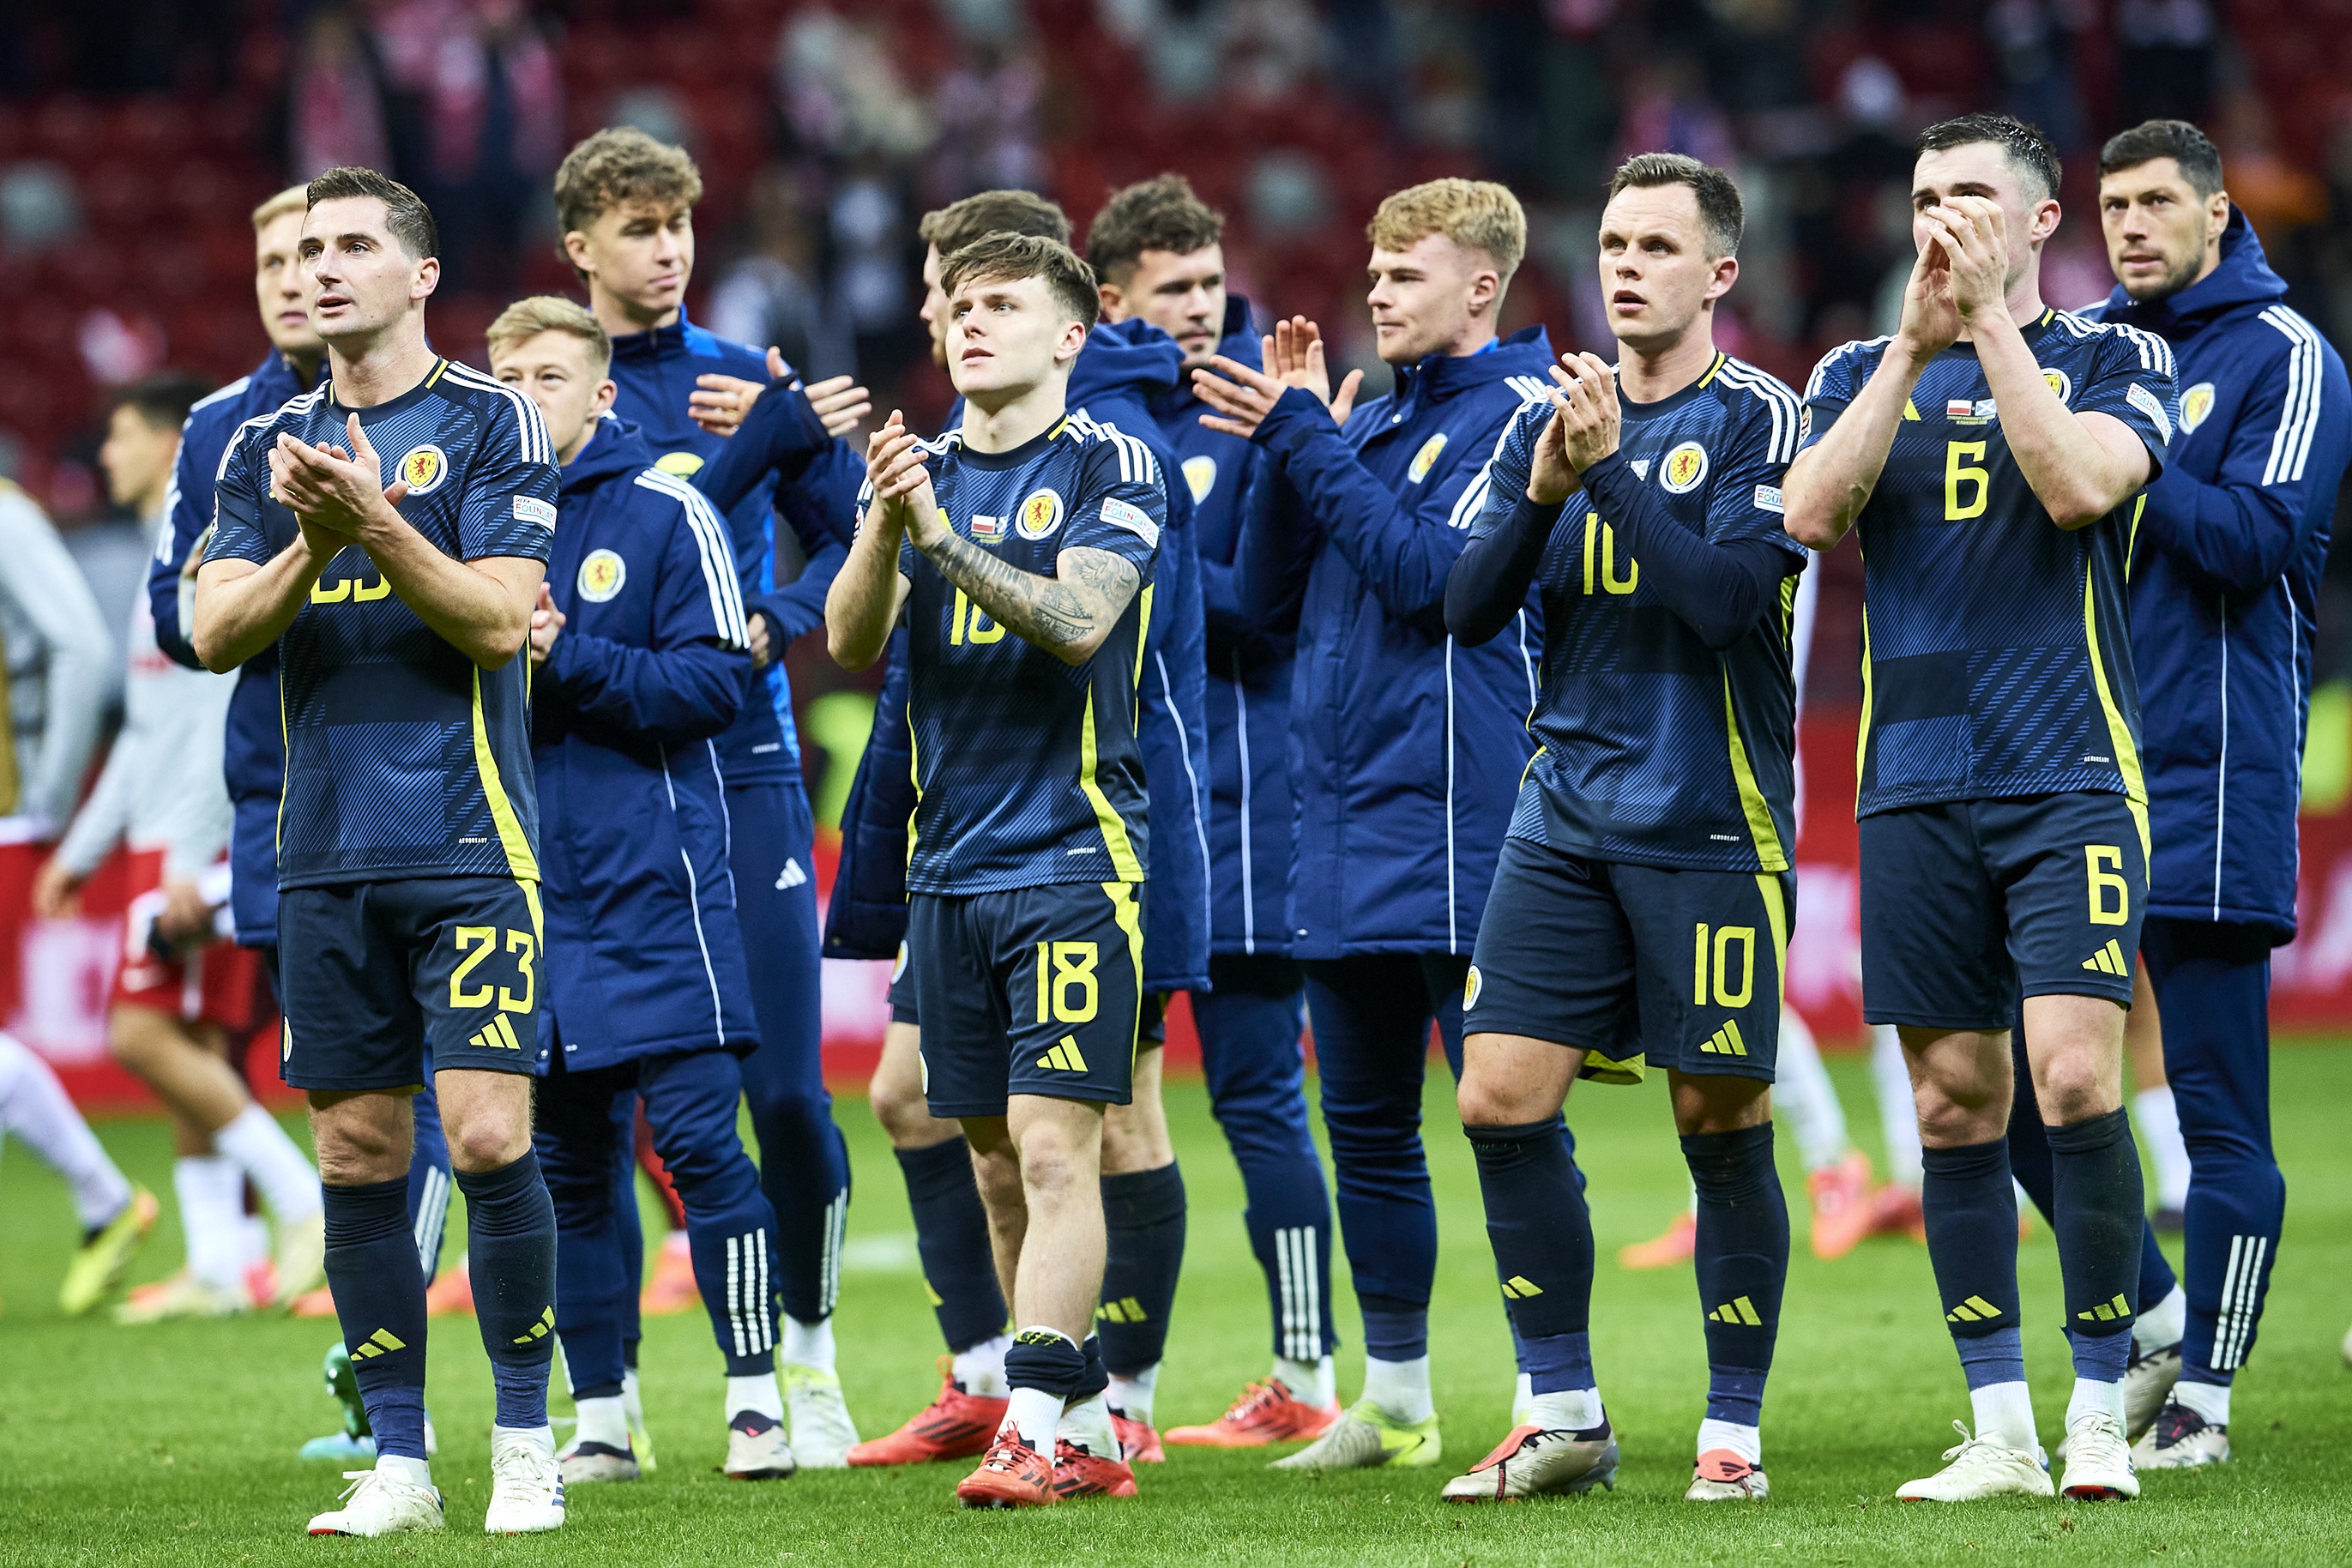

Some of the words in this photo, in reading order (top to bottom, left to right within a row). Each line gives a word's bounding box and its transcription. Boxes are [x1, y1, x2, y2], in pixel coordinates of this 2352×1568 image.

[1945, 440, 1989, 521] 6
[1583, 512, 1639, 594] 10
[2084, 845, 2128, 926] 6
[449, 926, 534, 1015] 23
[1037, 941, 1099, 1023] 18
[1695, 923, 1755, 1008] 10
